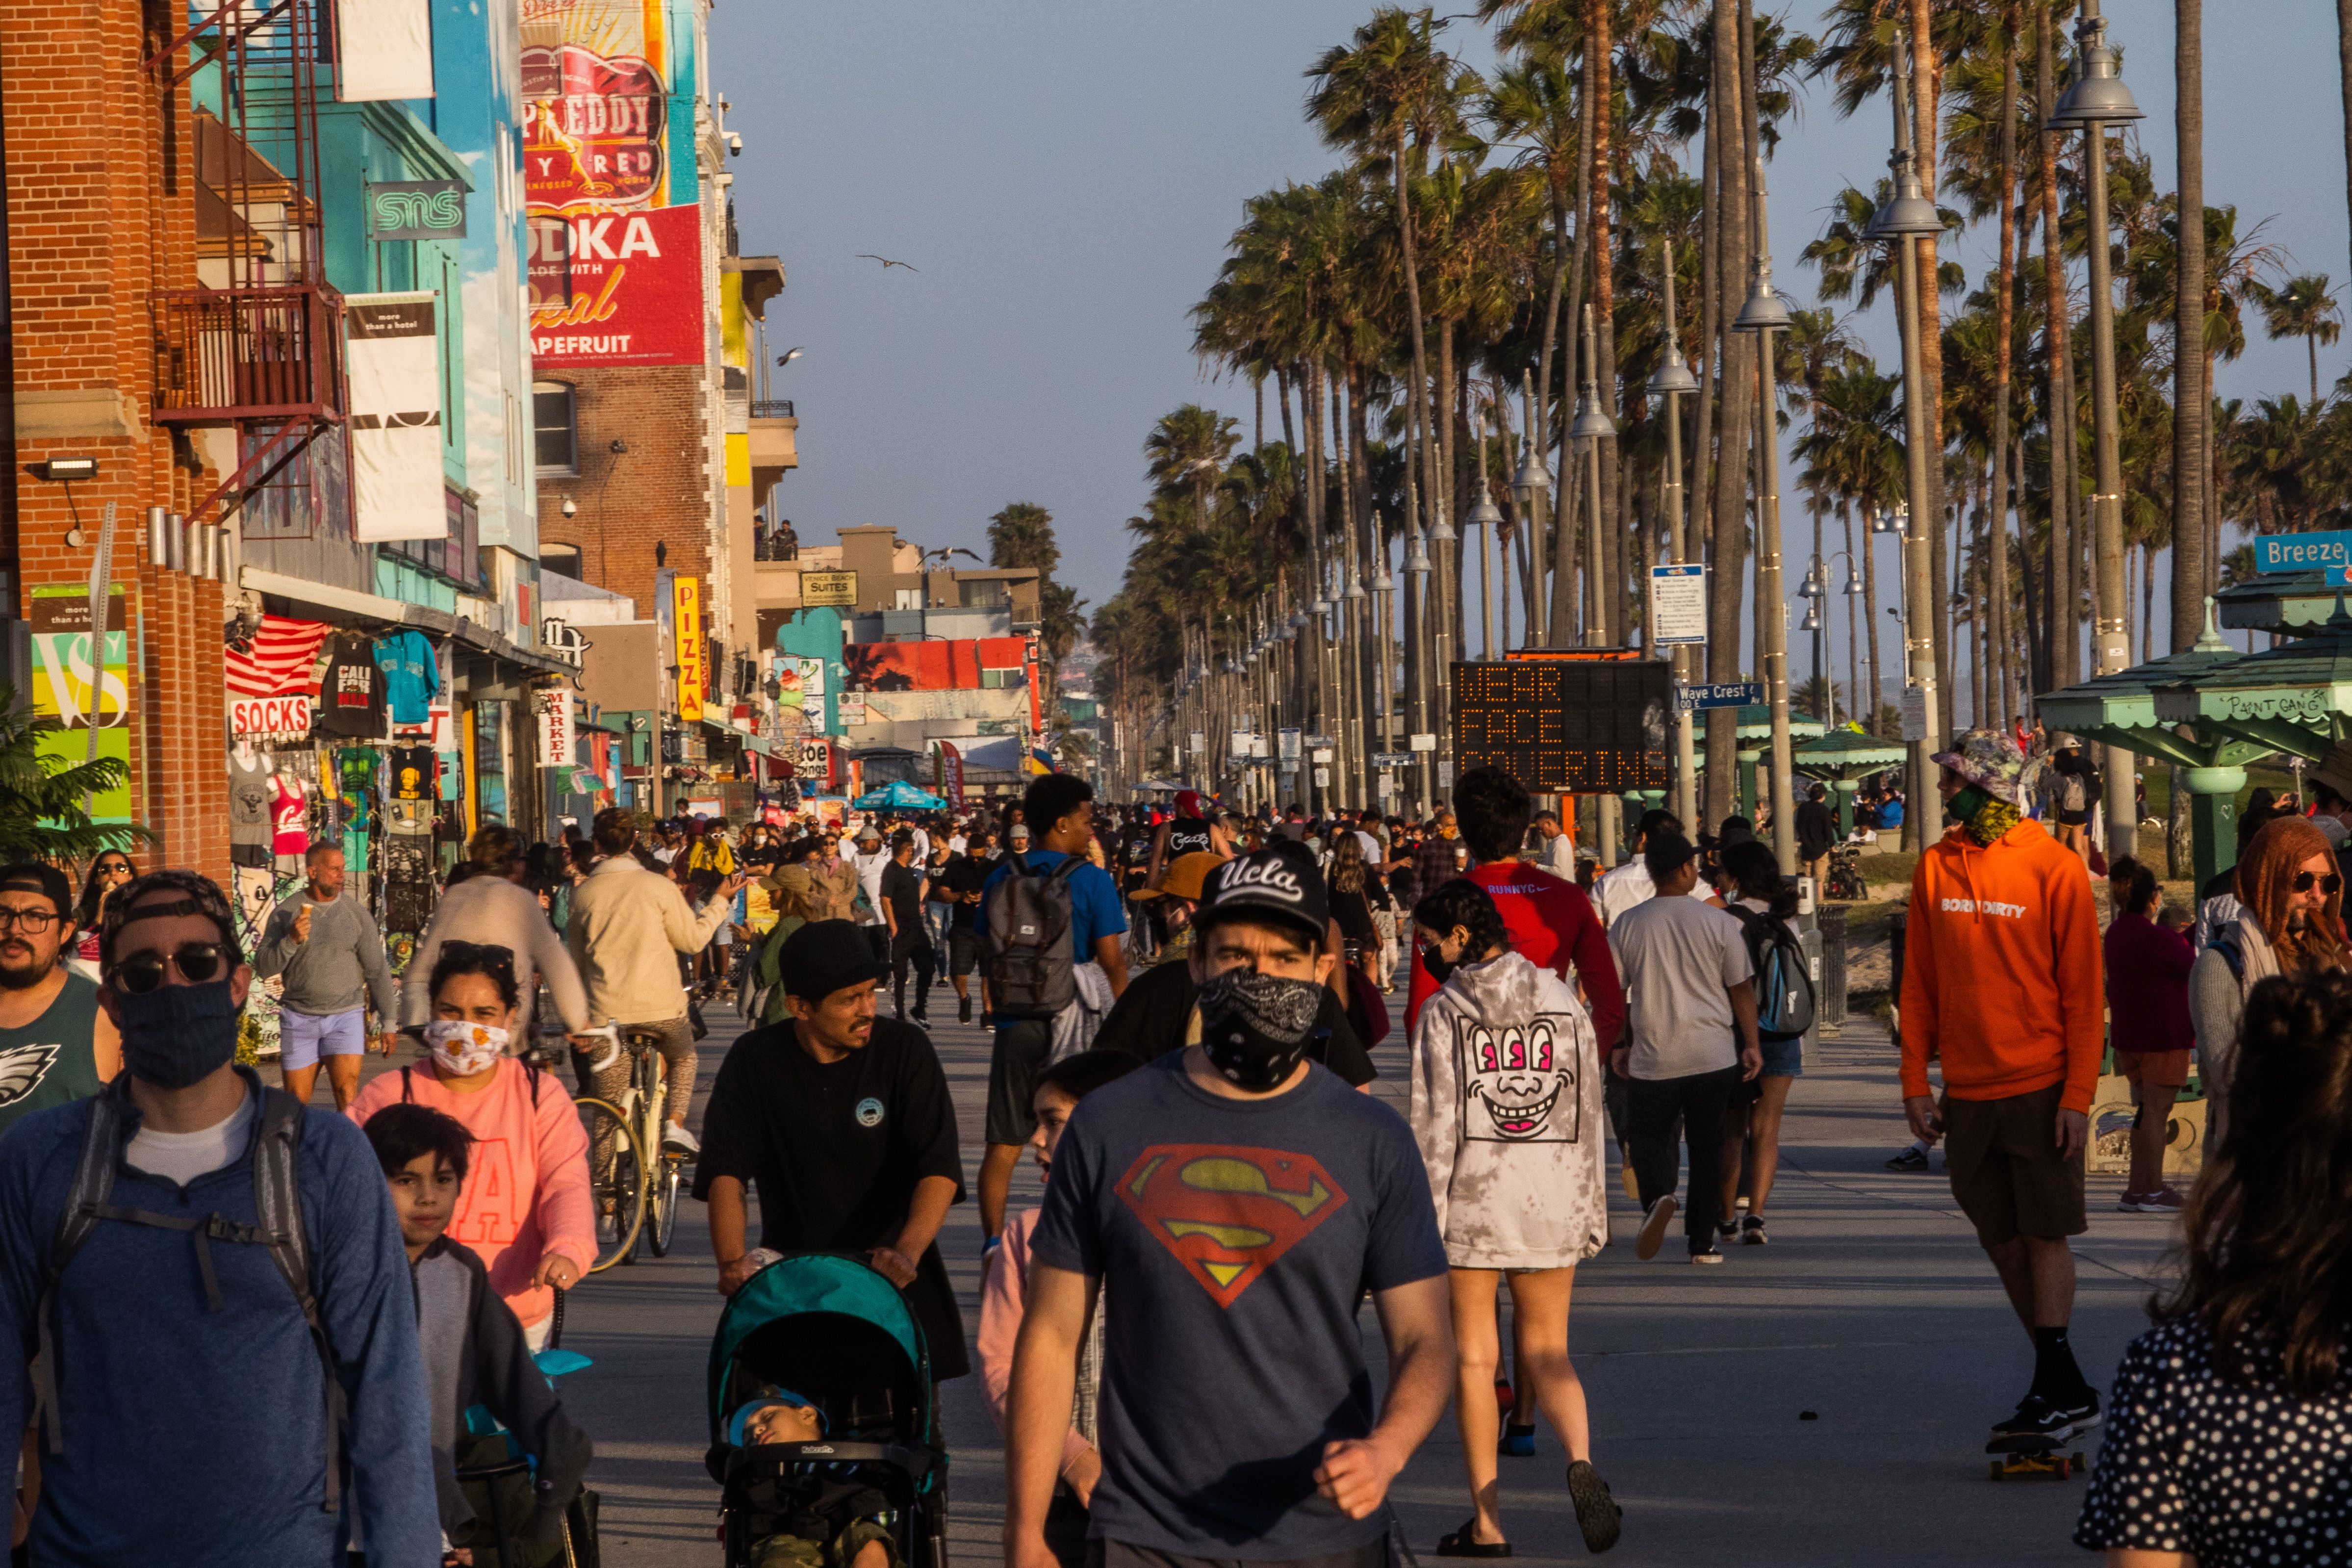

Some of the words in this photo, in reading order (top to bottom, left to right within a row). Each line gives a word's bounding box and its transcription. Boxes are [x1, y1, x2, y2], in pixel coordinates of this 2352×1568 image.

[567, 96, 647, 135] EDDY
[593, 152, 652, 173] RED
[2268, 541, 2344, 564] Breeze
[810, 582, 848, 592] SUITES
[680, 587, 699, 712] PIZZA
[338, 665, 371, 680] CALI
[1460, 667, 1561, 702] WEAR
[1679, 688, 1709, 700] Wave
[1713, 685, 1745, 698] Crest
[337, 693, 369, 707] NIA
[1694, 699, 1700, 708] E
[2279, 698, 2319, 712] GANG
[234, 698, 307, 734] SOCKS
[1461, 709, 1561, 744] FACE
[548, 693, 565, 763] MARKET
[1488, 884, 1535, 894] RUNNYC
[1942, 898, 1975, 913] BORN
[1982, 900, 2026, 919] DIRTY
